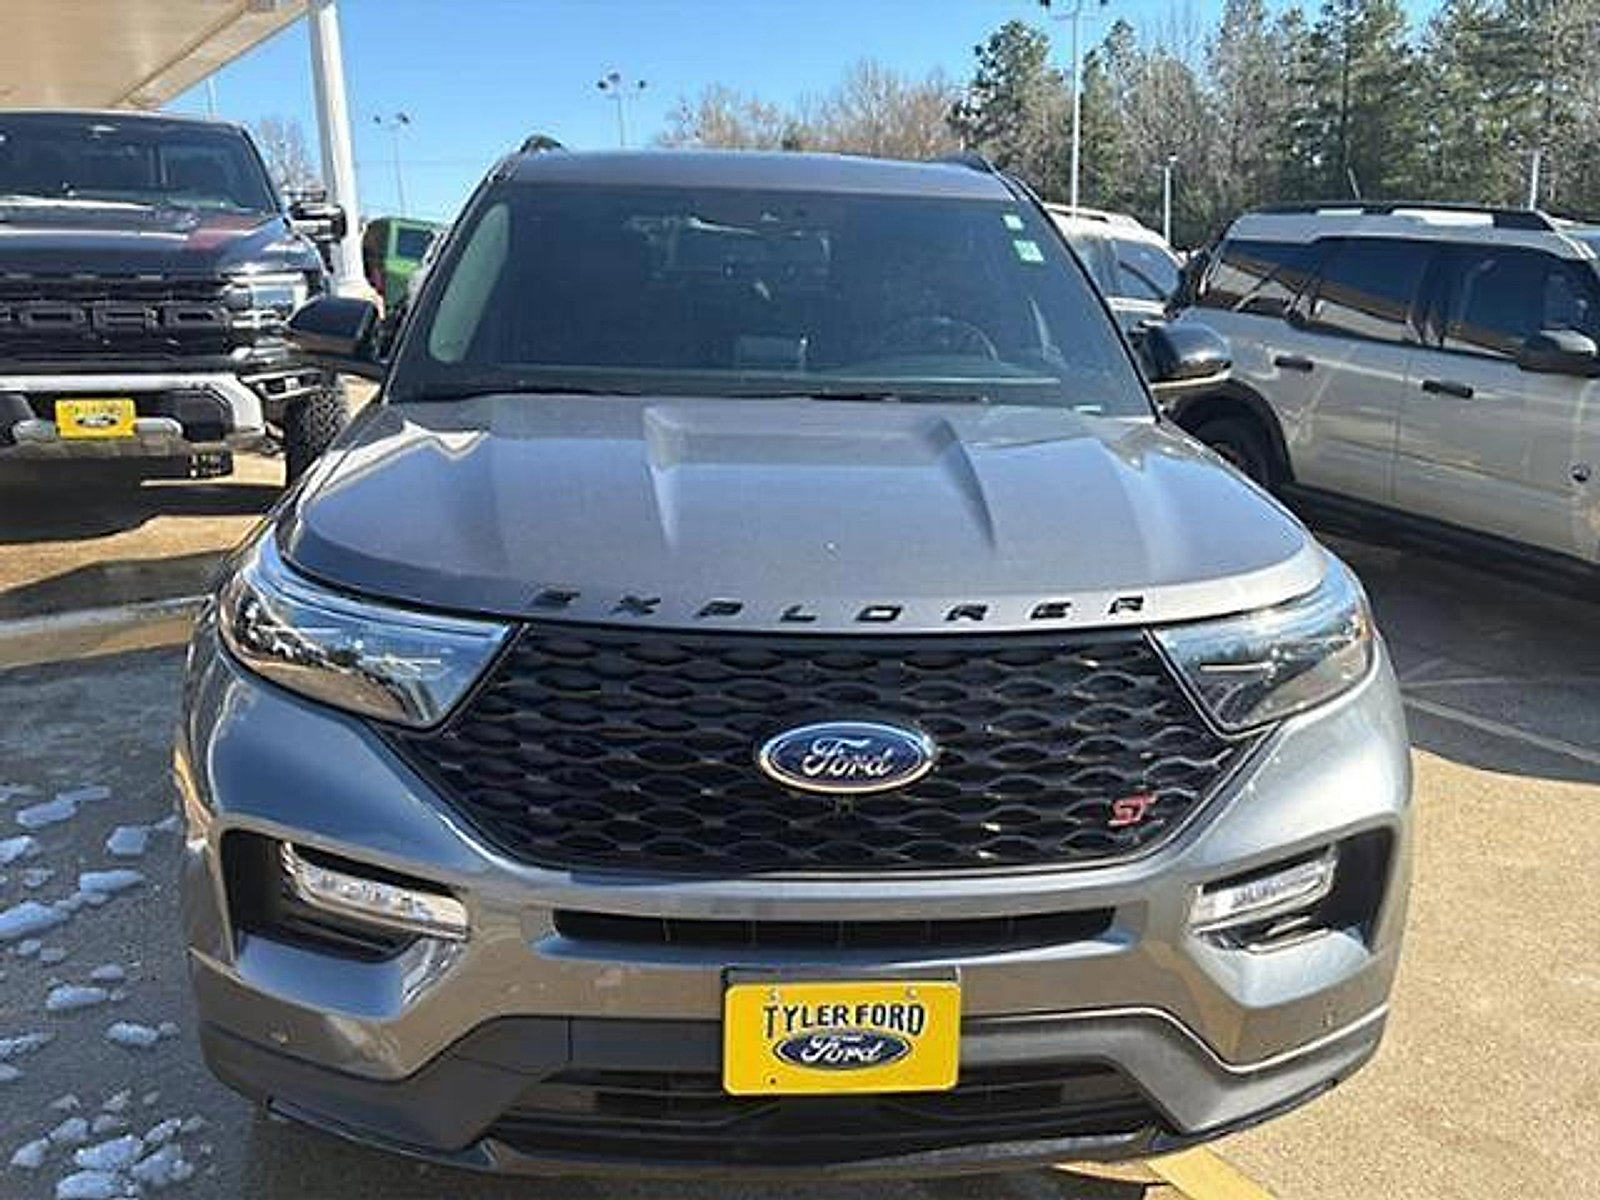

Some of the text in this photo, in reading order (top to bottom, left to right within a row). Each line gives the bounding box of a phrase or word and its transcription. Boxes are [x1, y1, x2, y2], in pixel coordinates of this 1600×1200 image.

[0, 300, 222, 333] ORD
[533, 587, 1145, 622] EXPLORER
[802, 738, 894, 777] Ford
[1108, 791, 1158, 828] ST
[763, 1004, 925, 1039] TYLER FORD
[800, 1034, 885, 1063] Ford
